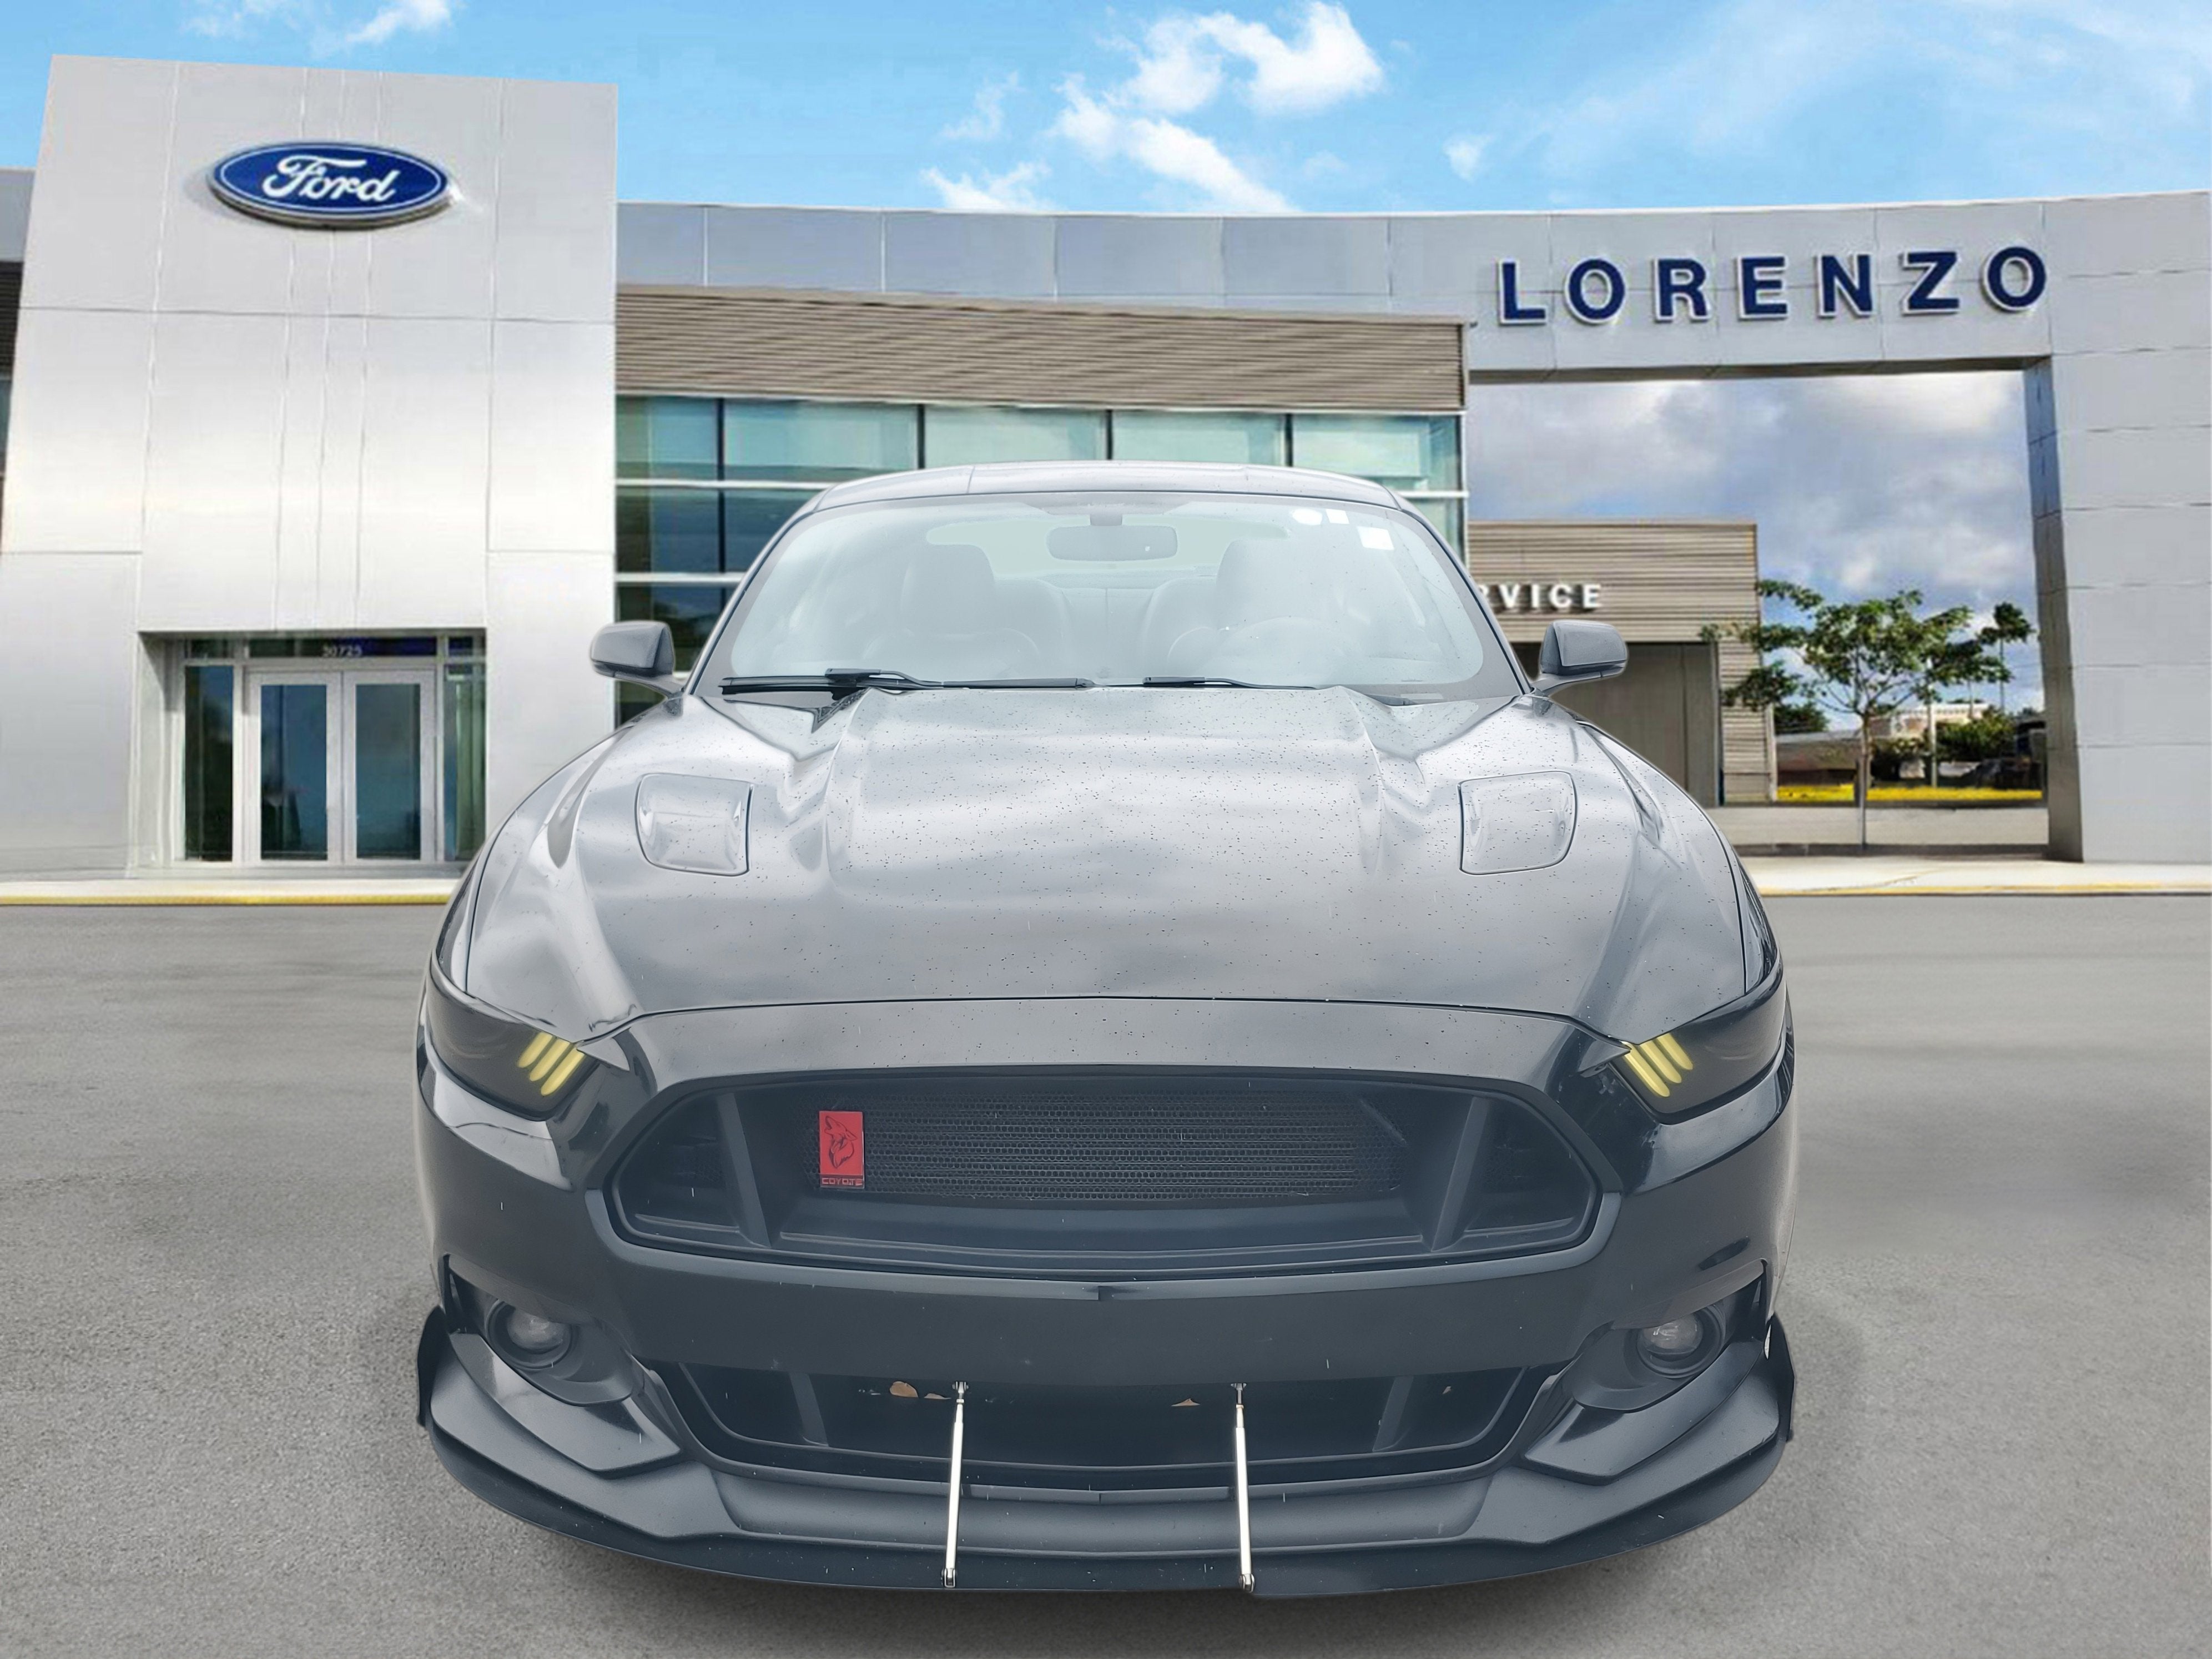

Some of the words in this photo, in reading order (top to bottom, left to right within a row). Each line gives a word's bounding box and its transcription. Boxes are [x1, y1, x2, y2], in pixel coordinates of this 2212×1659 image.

[262, 154, 400, 201] Ford
[1498, 246, 2047, 325] LORENZO
[822, 1177, 863, 1186] COYOTE
